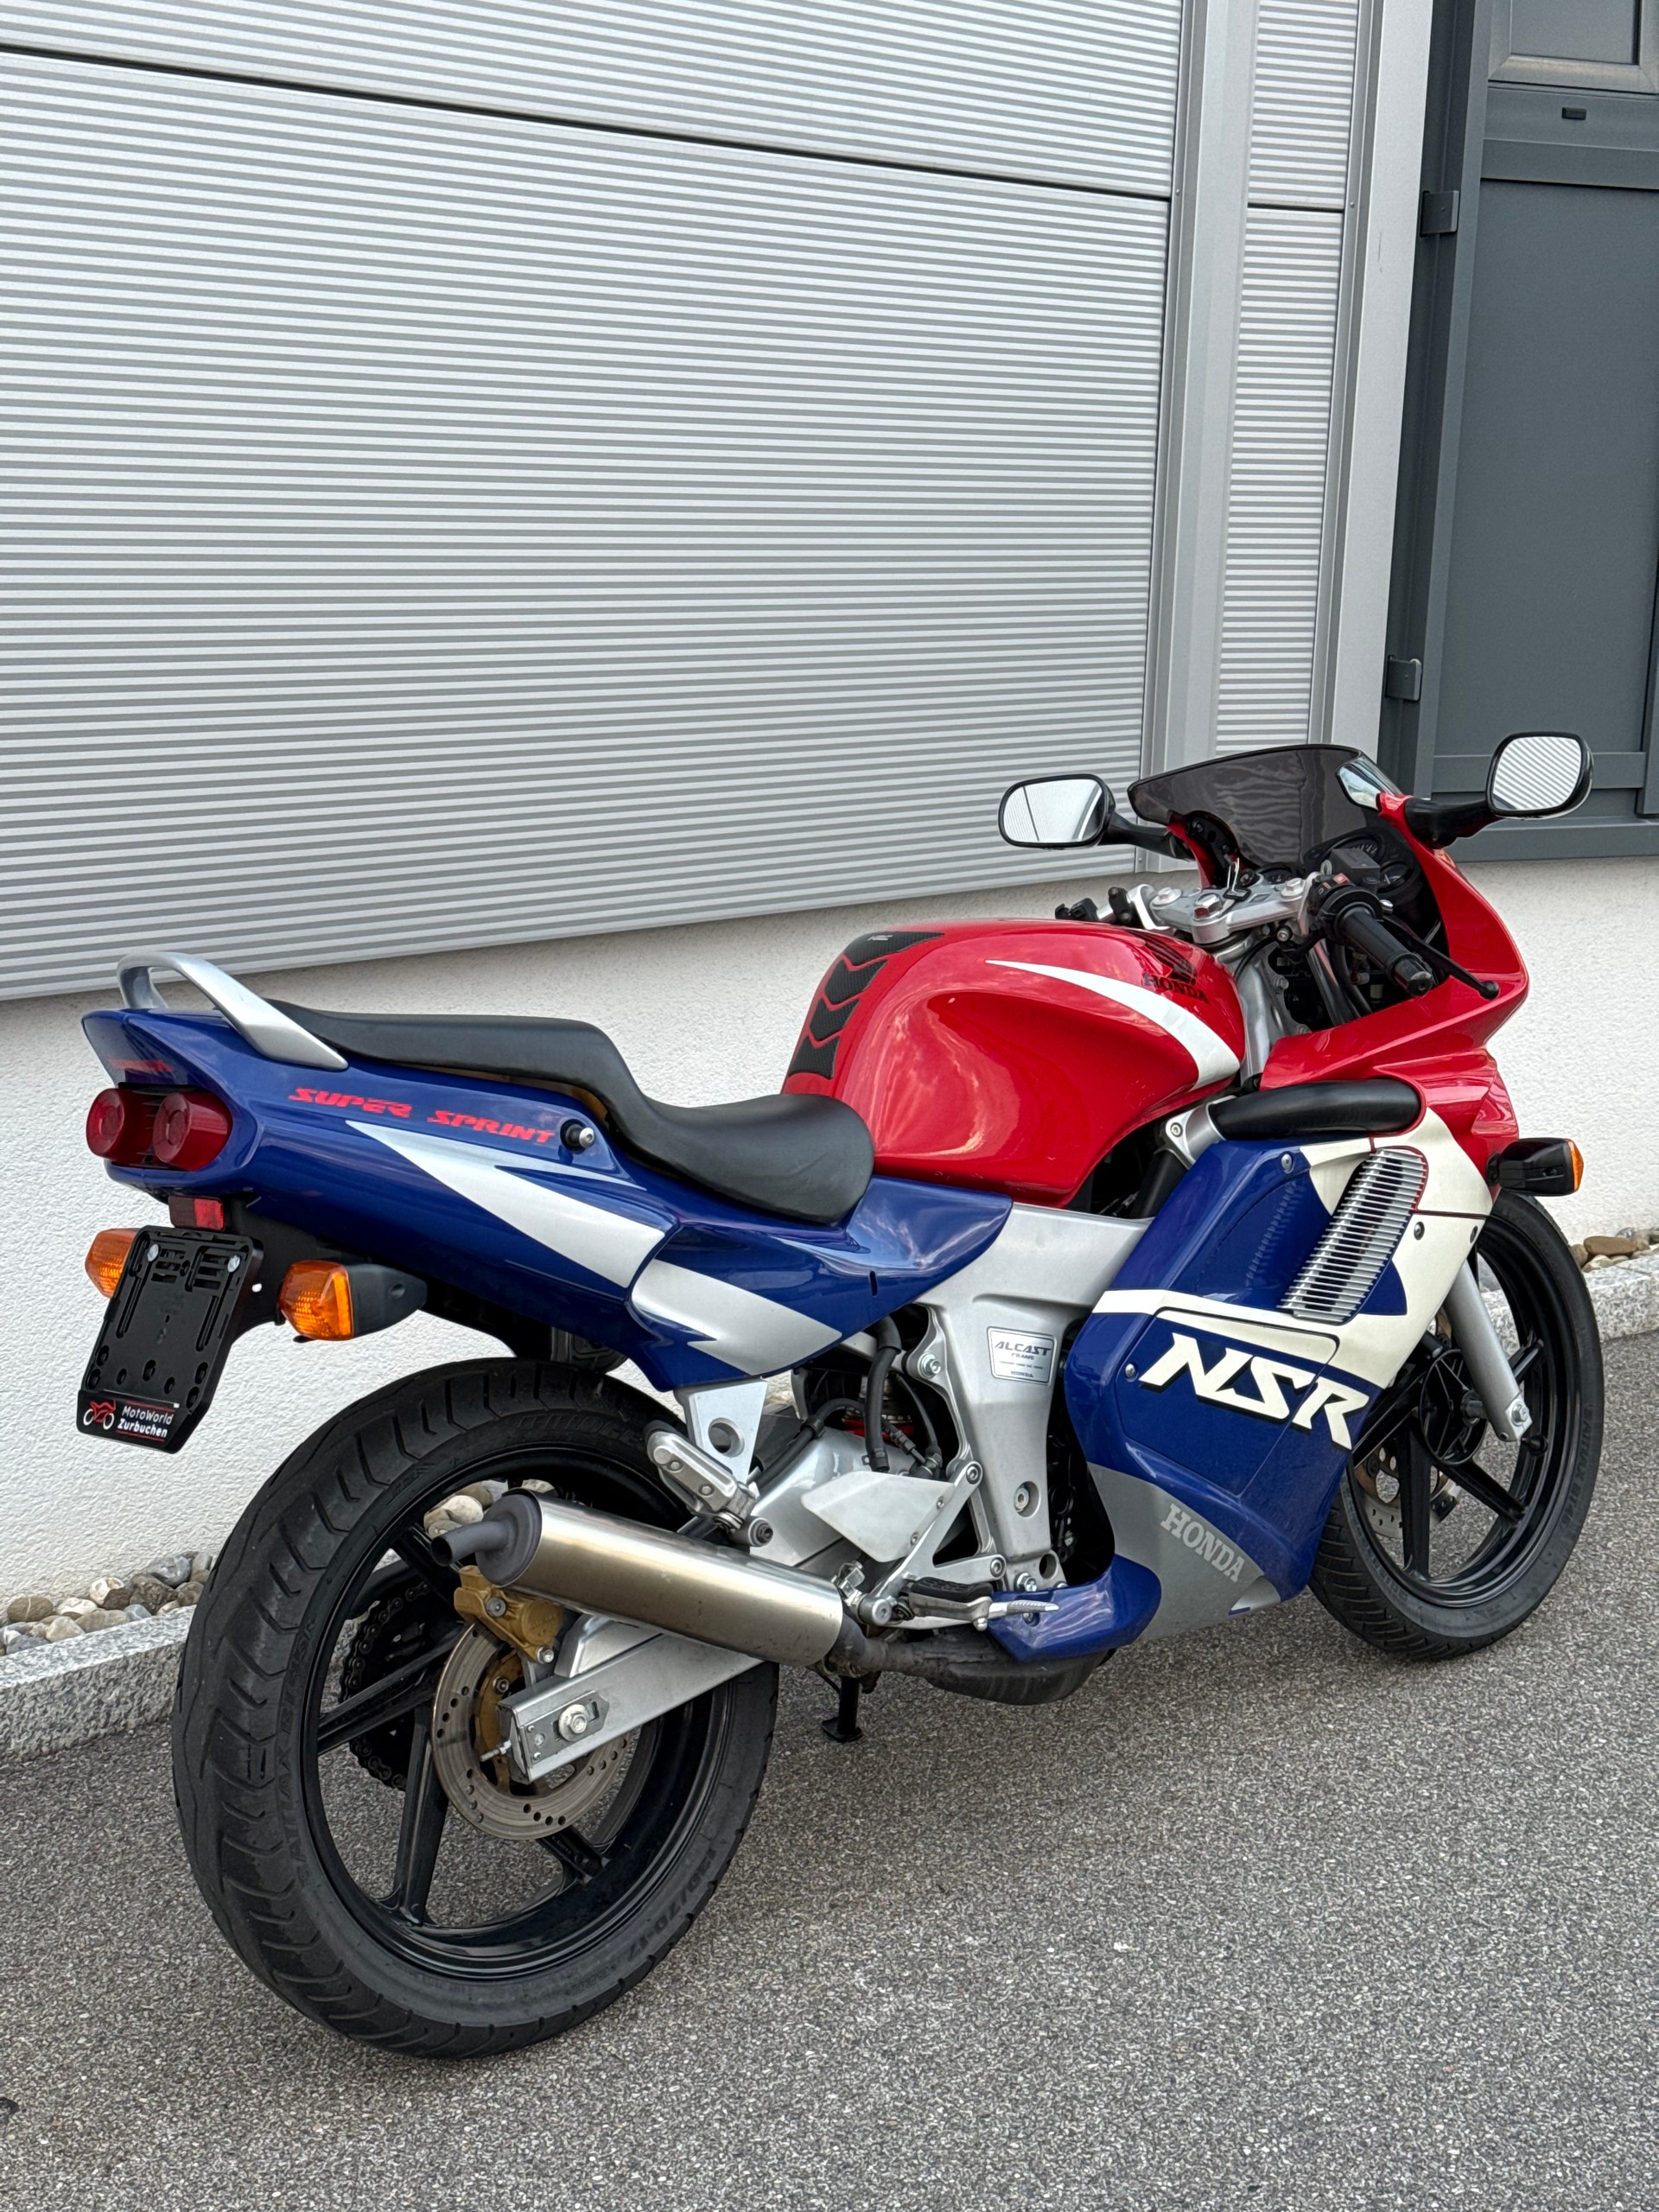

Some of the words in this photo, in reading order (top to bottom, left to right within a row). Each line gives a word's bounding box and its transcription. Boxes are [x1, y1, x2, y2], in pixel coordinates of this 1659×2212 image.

[1141, 972, 1209, 1004] HONDA
[288, 1087, 413, 1118] SUPER
[427, 1109, 556, 1145] SPRINT
[994, 1340, 1052, 1357] ALCAST
[1138, 1332, 1370, 1451] NSR
[117, 1418, 168, 1438] Zurbuchen
[122, 1405, 174, 1425] MotoWorld
[1160, 1503, 1245, 1583] HONDA
